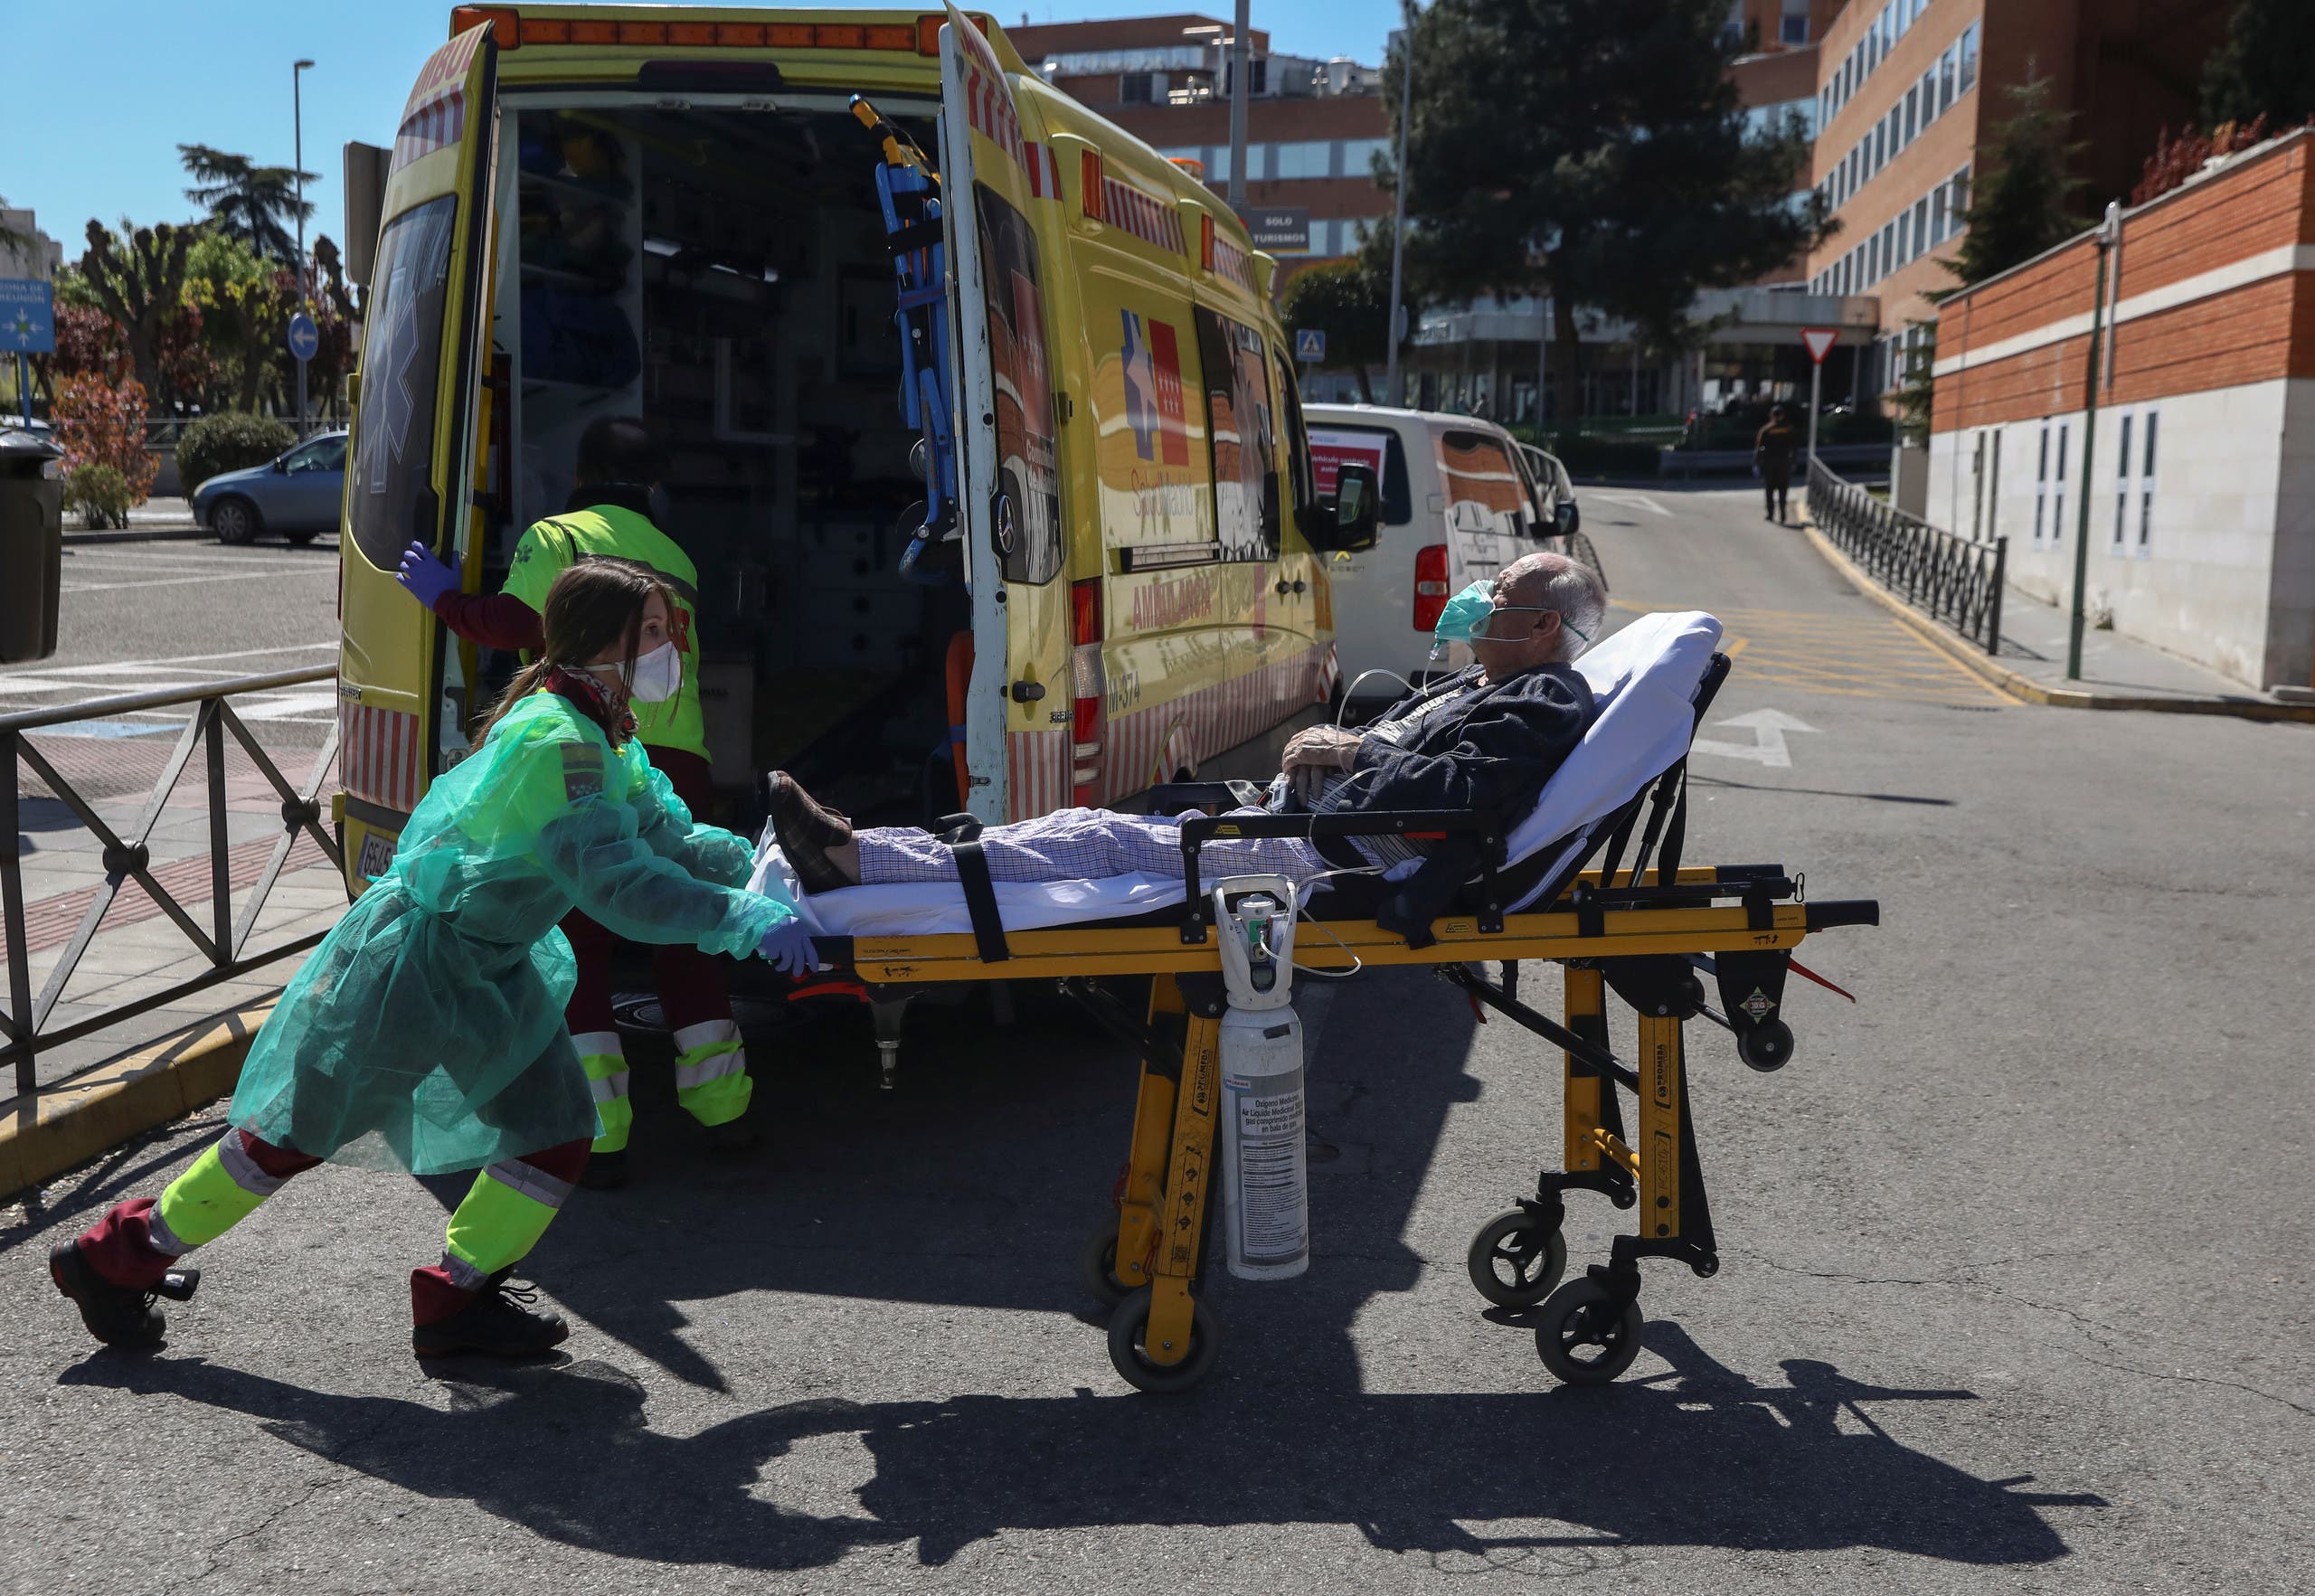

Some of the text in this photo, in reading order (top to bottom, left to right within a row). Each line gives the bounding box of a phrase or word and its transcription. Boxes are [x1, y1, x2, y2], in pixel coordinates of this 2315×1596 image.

[1266, 217, 1293, 226] SOLO
[1253, 233, 1307, 243] TURISMOS
[1133, 576, 1212, 631] AMBULANCIA
[1107, 671, 1141, 713] M-374
[1255, 1100, 1279, 1109] Oxígeno
[1250, 1109, 1271, 1118] Liquide
[1271, 1105, 1294, 1116] Medicinal
[1245, 1118, 1255, 1126] gas
[1256, 1116, 1288, 1127] comprimido
